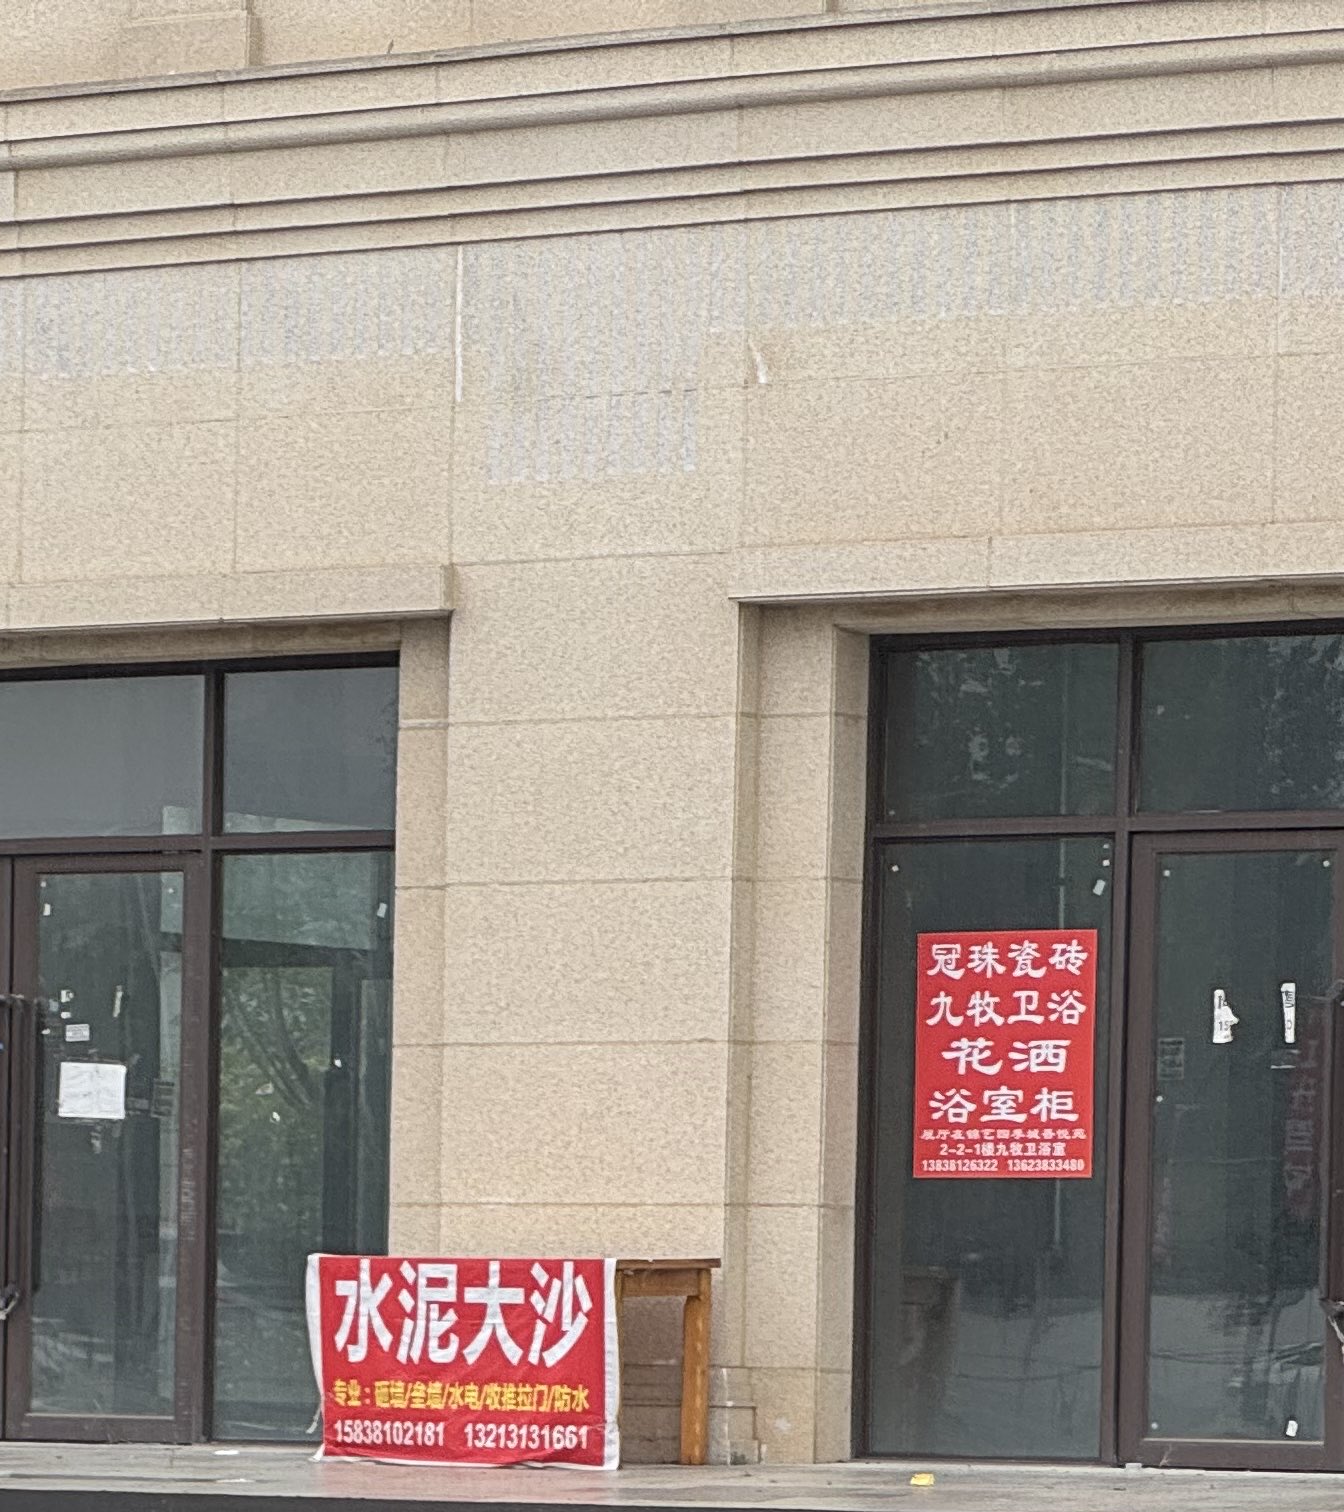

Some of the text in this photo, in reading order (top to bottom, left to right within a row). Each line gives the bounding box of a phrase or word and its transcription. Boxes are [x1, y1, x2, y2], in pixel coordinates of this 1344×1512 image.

[927, 939, 1088, 980] 冠珠瓷砖
[926, 989, 1087, 1027] 九牧卫浴
[941, 1037, 1072, 1075] 花洒
[929, 1086, 1079, 1123] 浴室柜
[333, 1258, 594, 1368] 水泥大沙
[334, 1419, 589, 1450] 15838102181 13213131661
